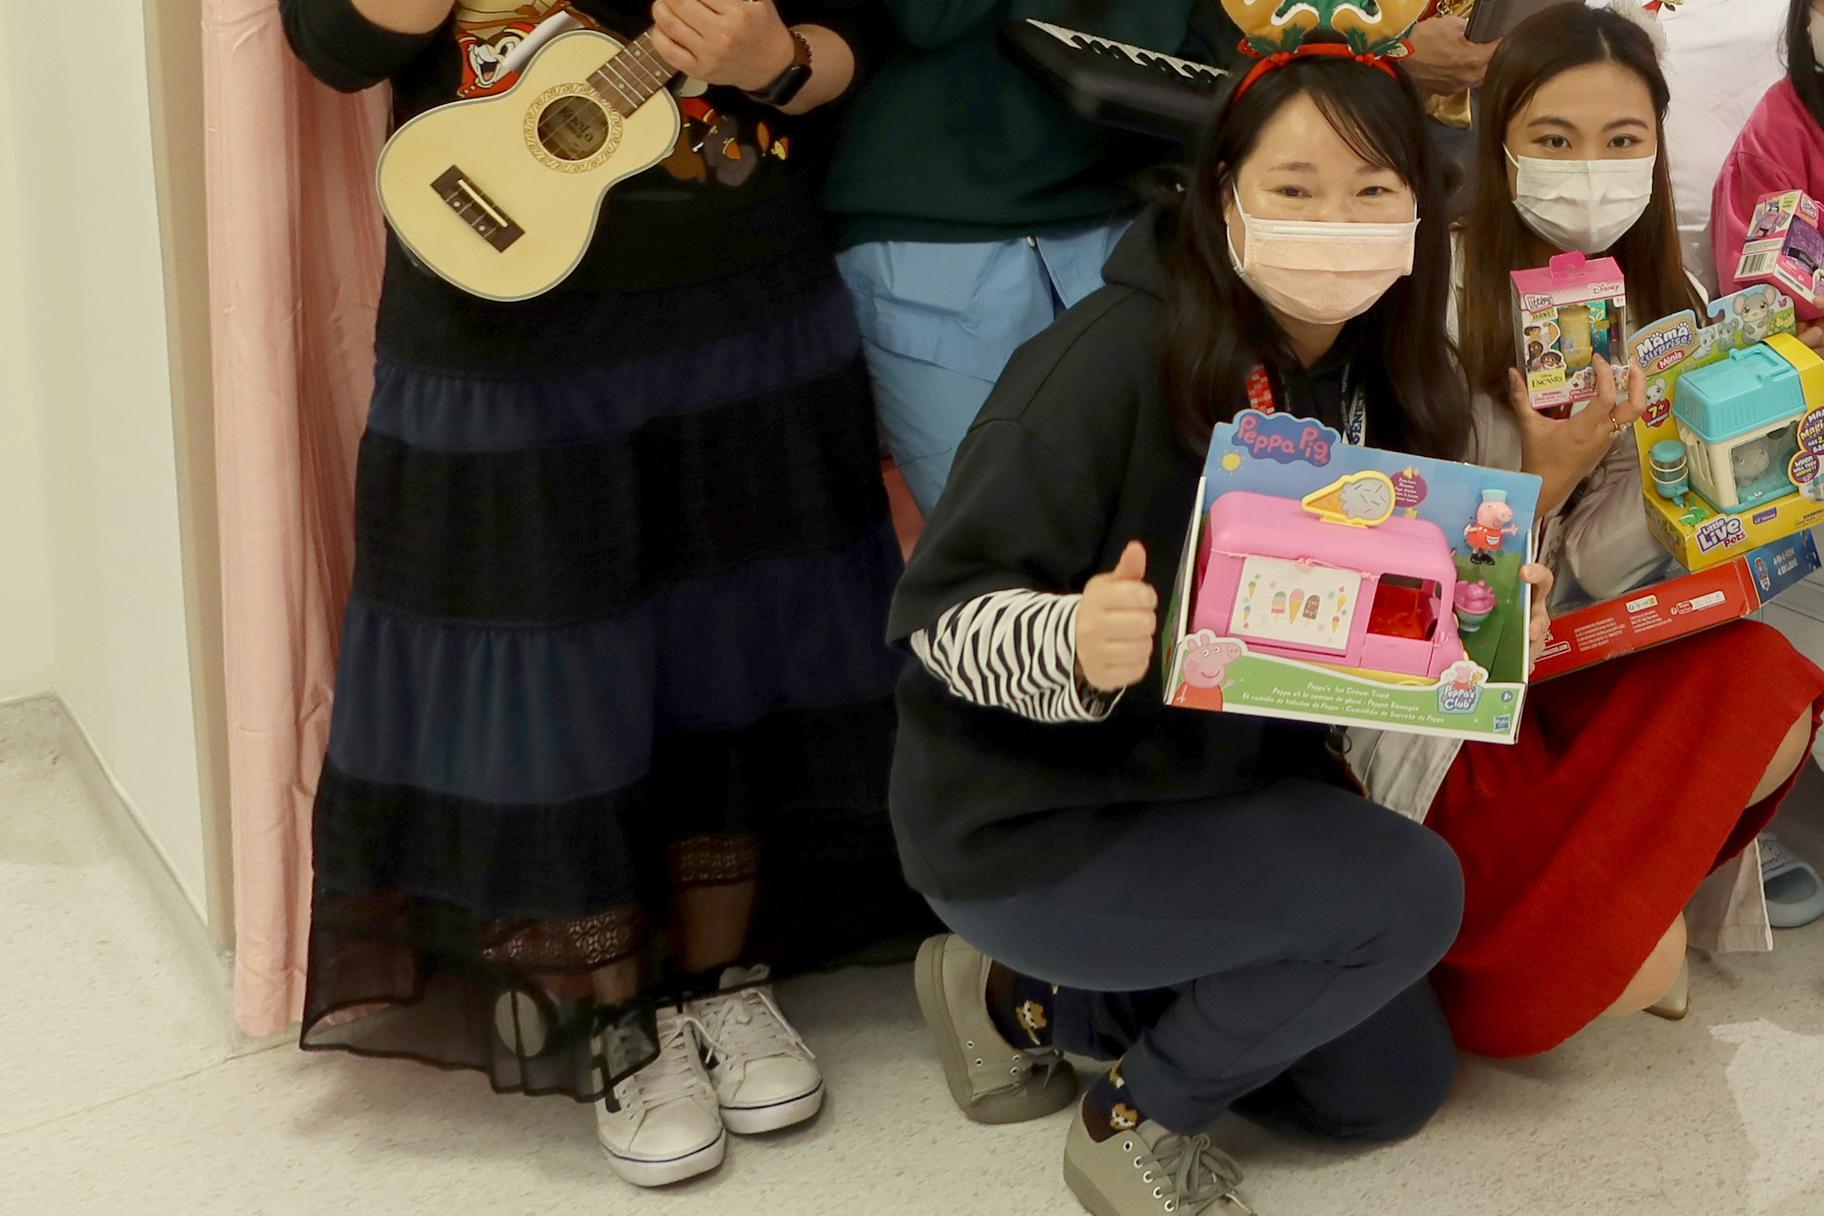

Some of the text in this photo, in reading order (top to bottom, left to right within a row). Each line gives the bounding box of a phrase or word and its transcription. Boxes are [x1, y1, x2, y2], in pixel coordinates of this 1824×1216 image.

[1659, 351, 1683, 370] Minis
[1237, 414, 1330, 465] Peppa Pig
[1444, 697, 1471, 711] Club
